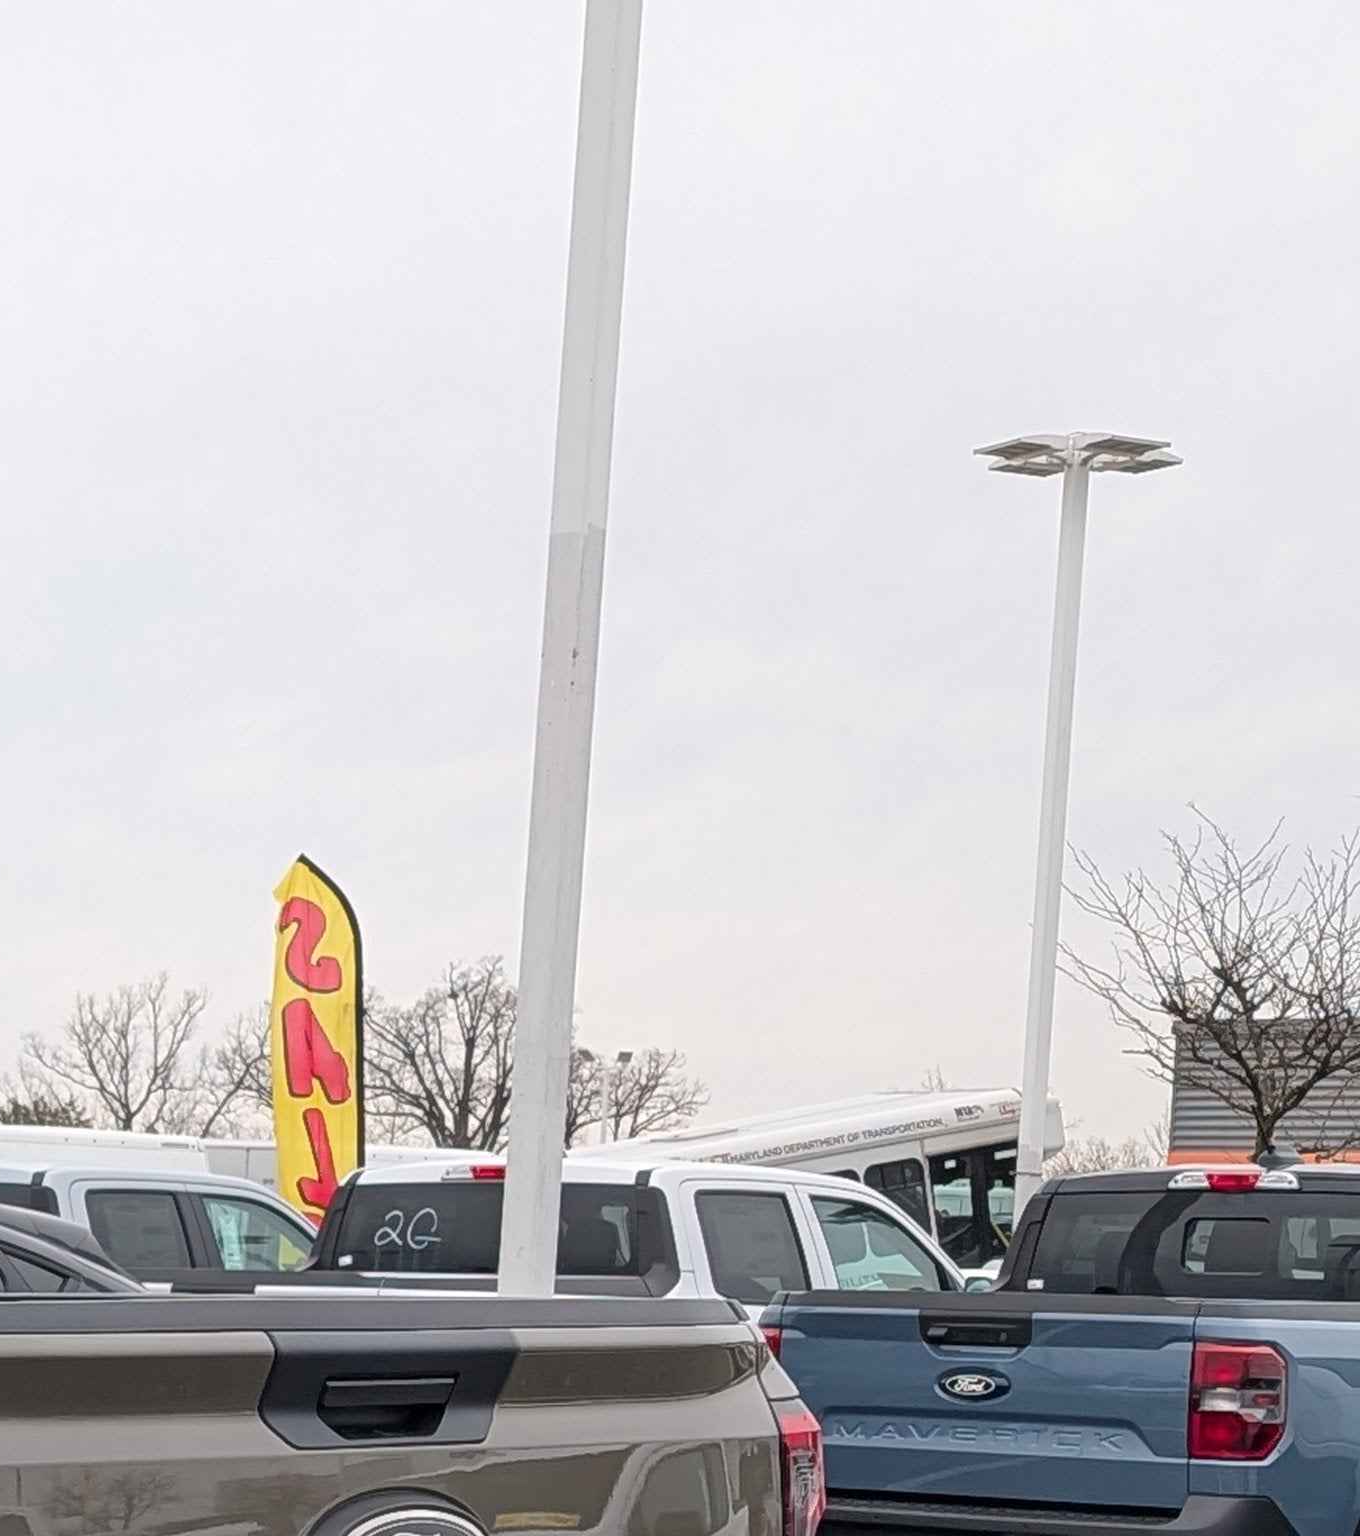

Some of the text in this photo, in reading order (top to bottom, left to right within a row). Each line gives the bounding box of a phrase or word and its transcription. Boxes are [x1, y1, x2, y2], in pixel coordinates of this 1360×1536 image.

[784, 1134, 845, 1154] DEPARTMENT
[847, 1132, 860, 1143] OF
[953, 1376, 986, 1394] Ford
[832, 1420, 1124, 1451] MAVERICK
